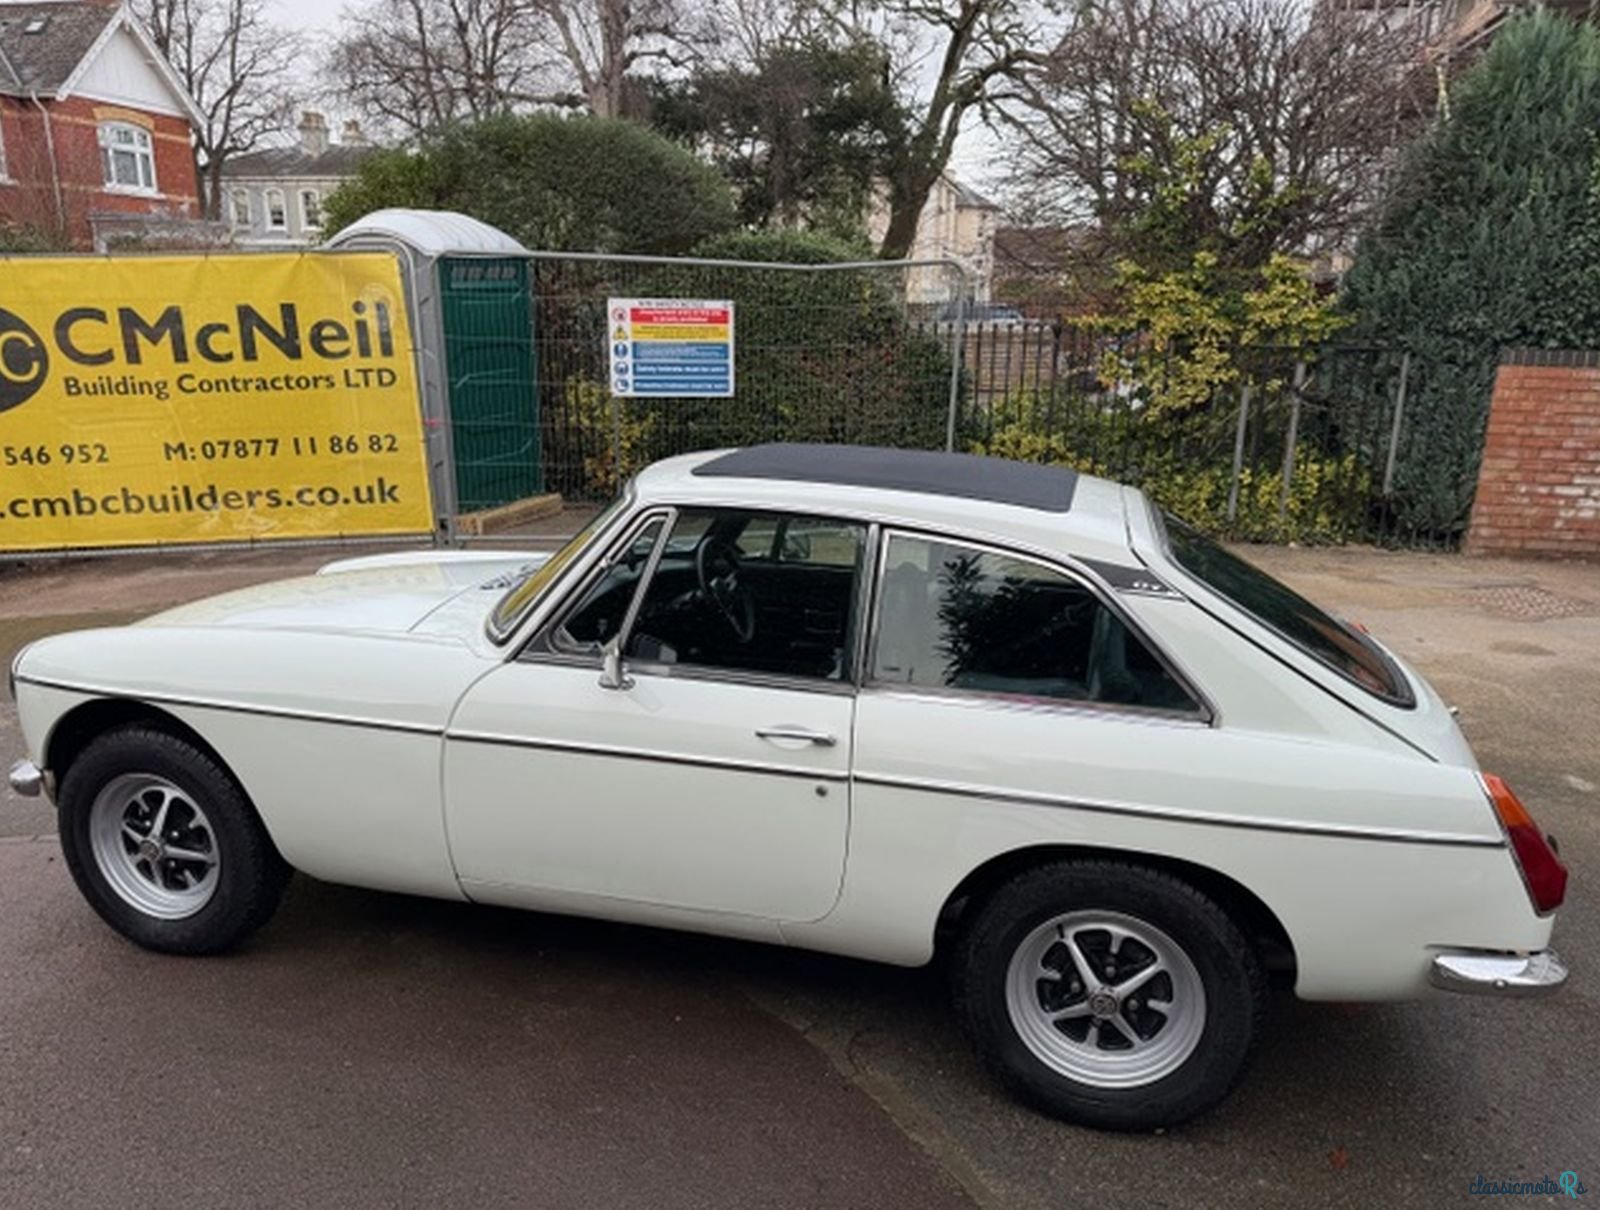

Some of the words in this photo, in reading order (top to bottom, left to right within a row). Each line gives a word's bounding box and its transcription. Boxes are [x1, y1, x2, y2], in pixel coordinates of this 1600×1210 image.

[54, 301, 394, 365] CMcNeil
[64, 375, 170, 400] Building
[176, 374, 335, 394] Contractors
[344, 368, 397, 388] LTD
[4, 446, 51, 466] 546
[60, 443, 109, 464] 952
[294, 437, 317, 456] 11
[329, 434, 359, 454] 86
[368, 433, 398, 453] 82
